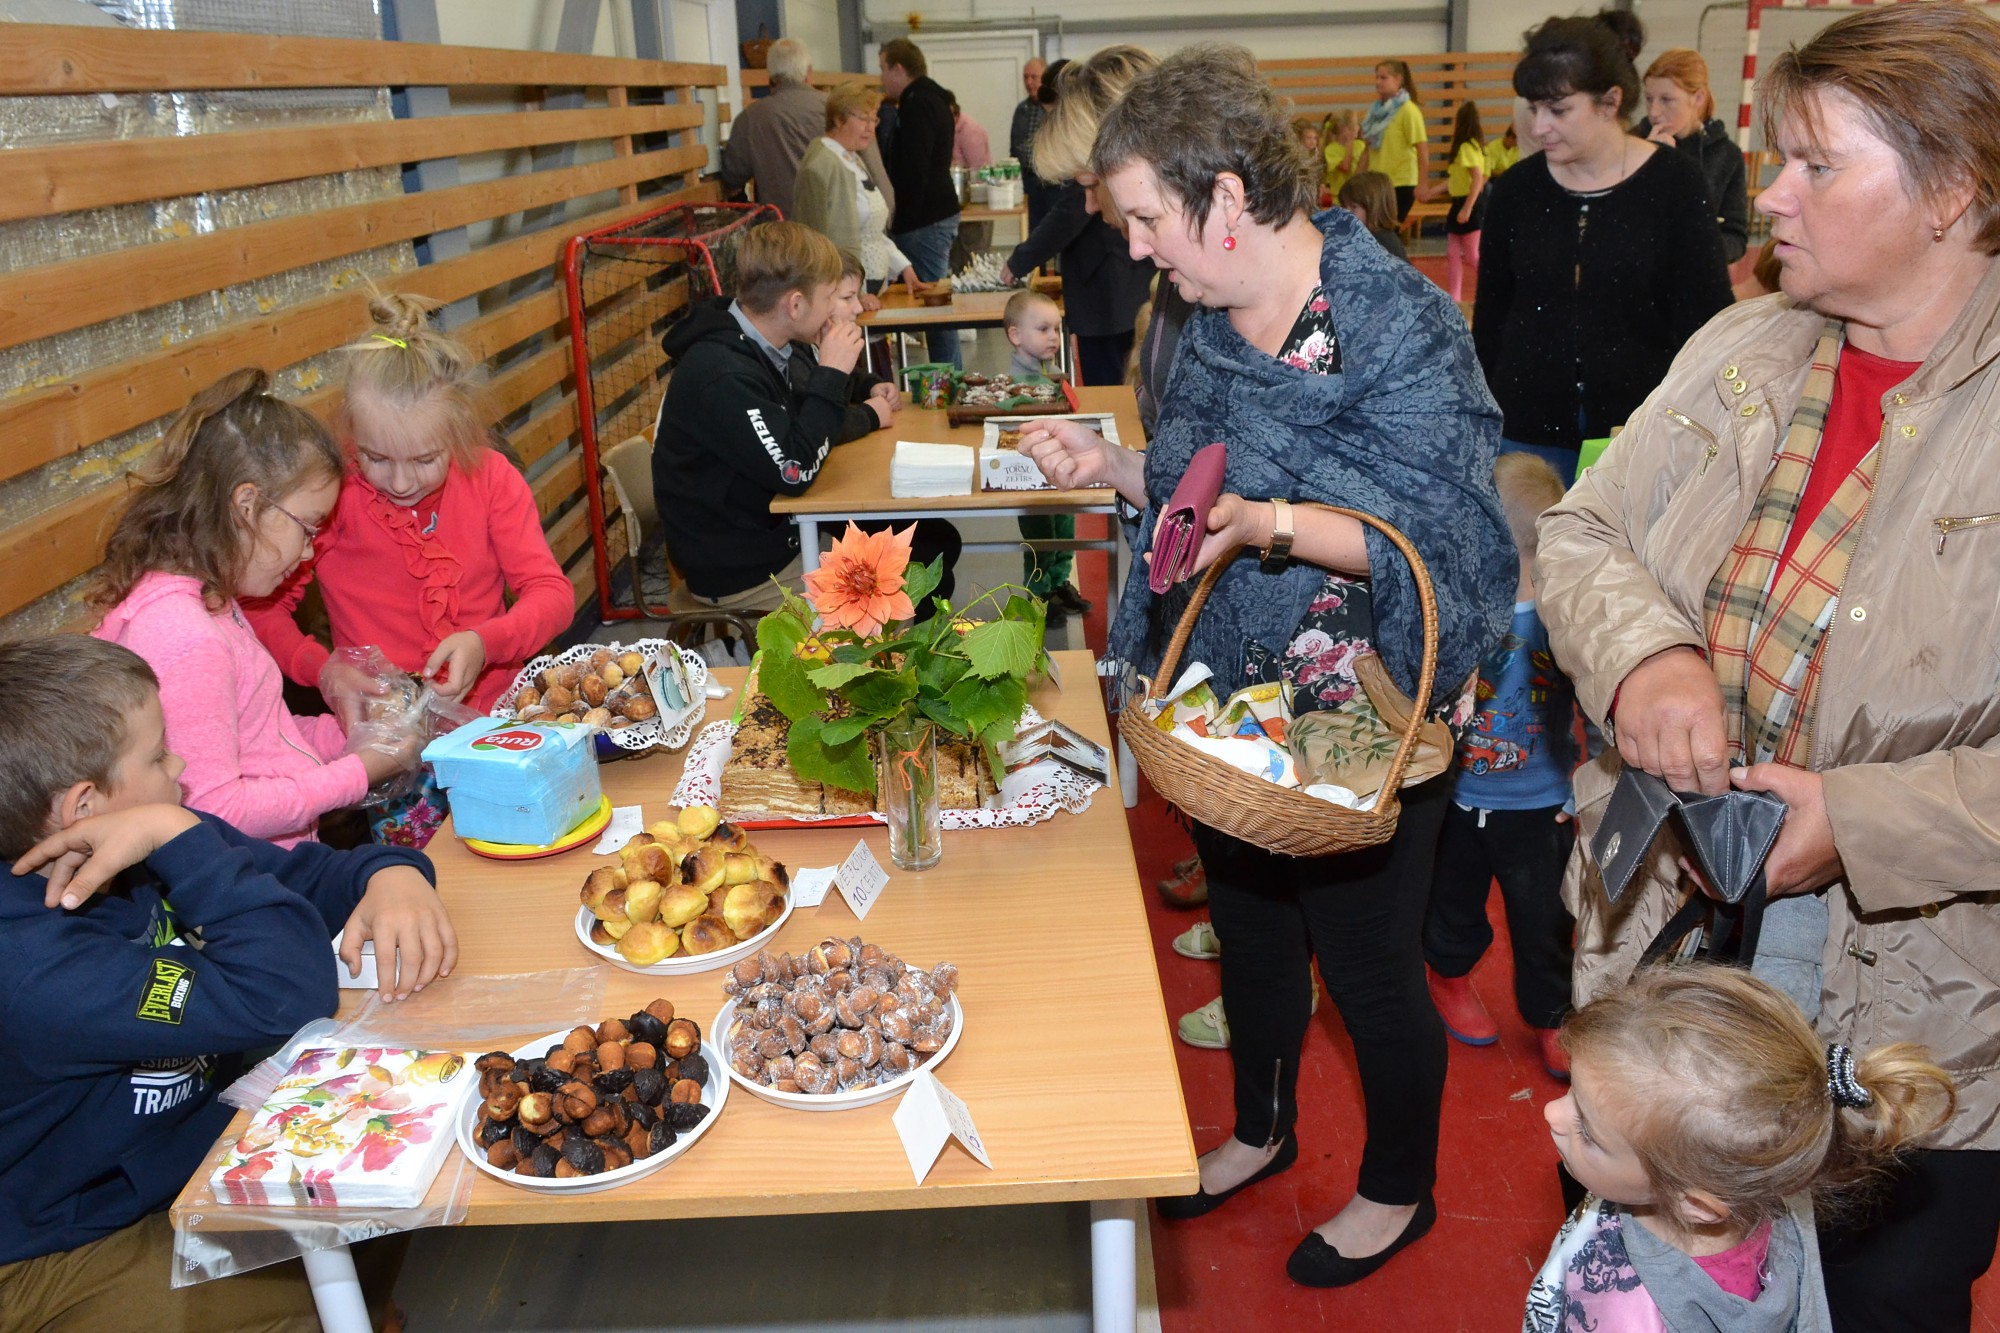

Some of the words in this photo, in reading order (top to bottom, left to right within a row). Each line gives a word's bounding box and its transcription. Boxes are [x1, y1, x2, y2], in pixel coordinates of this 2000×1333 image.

[484, 736, 539, 747] Ruta
[139, 960, 188, 1021] EVERLAST
[170, 978, 190, 1009] BOXING
[133, 1078, 193, 1115] TRAIN.
